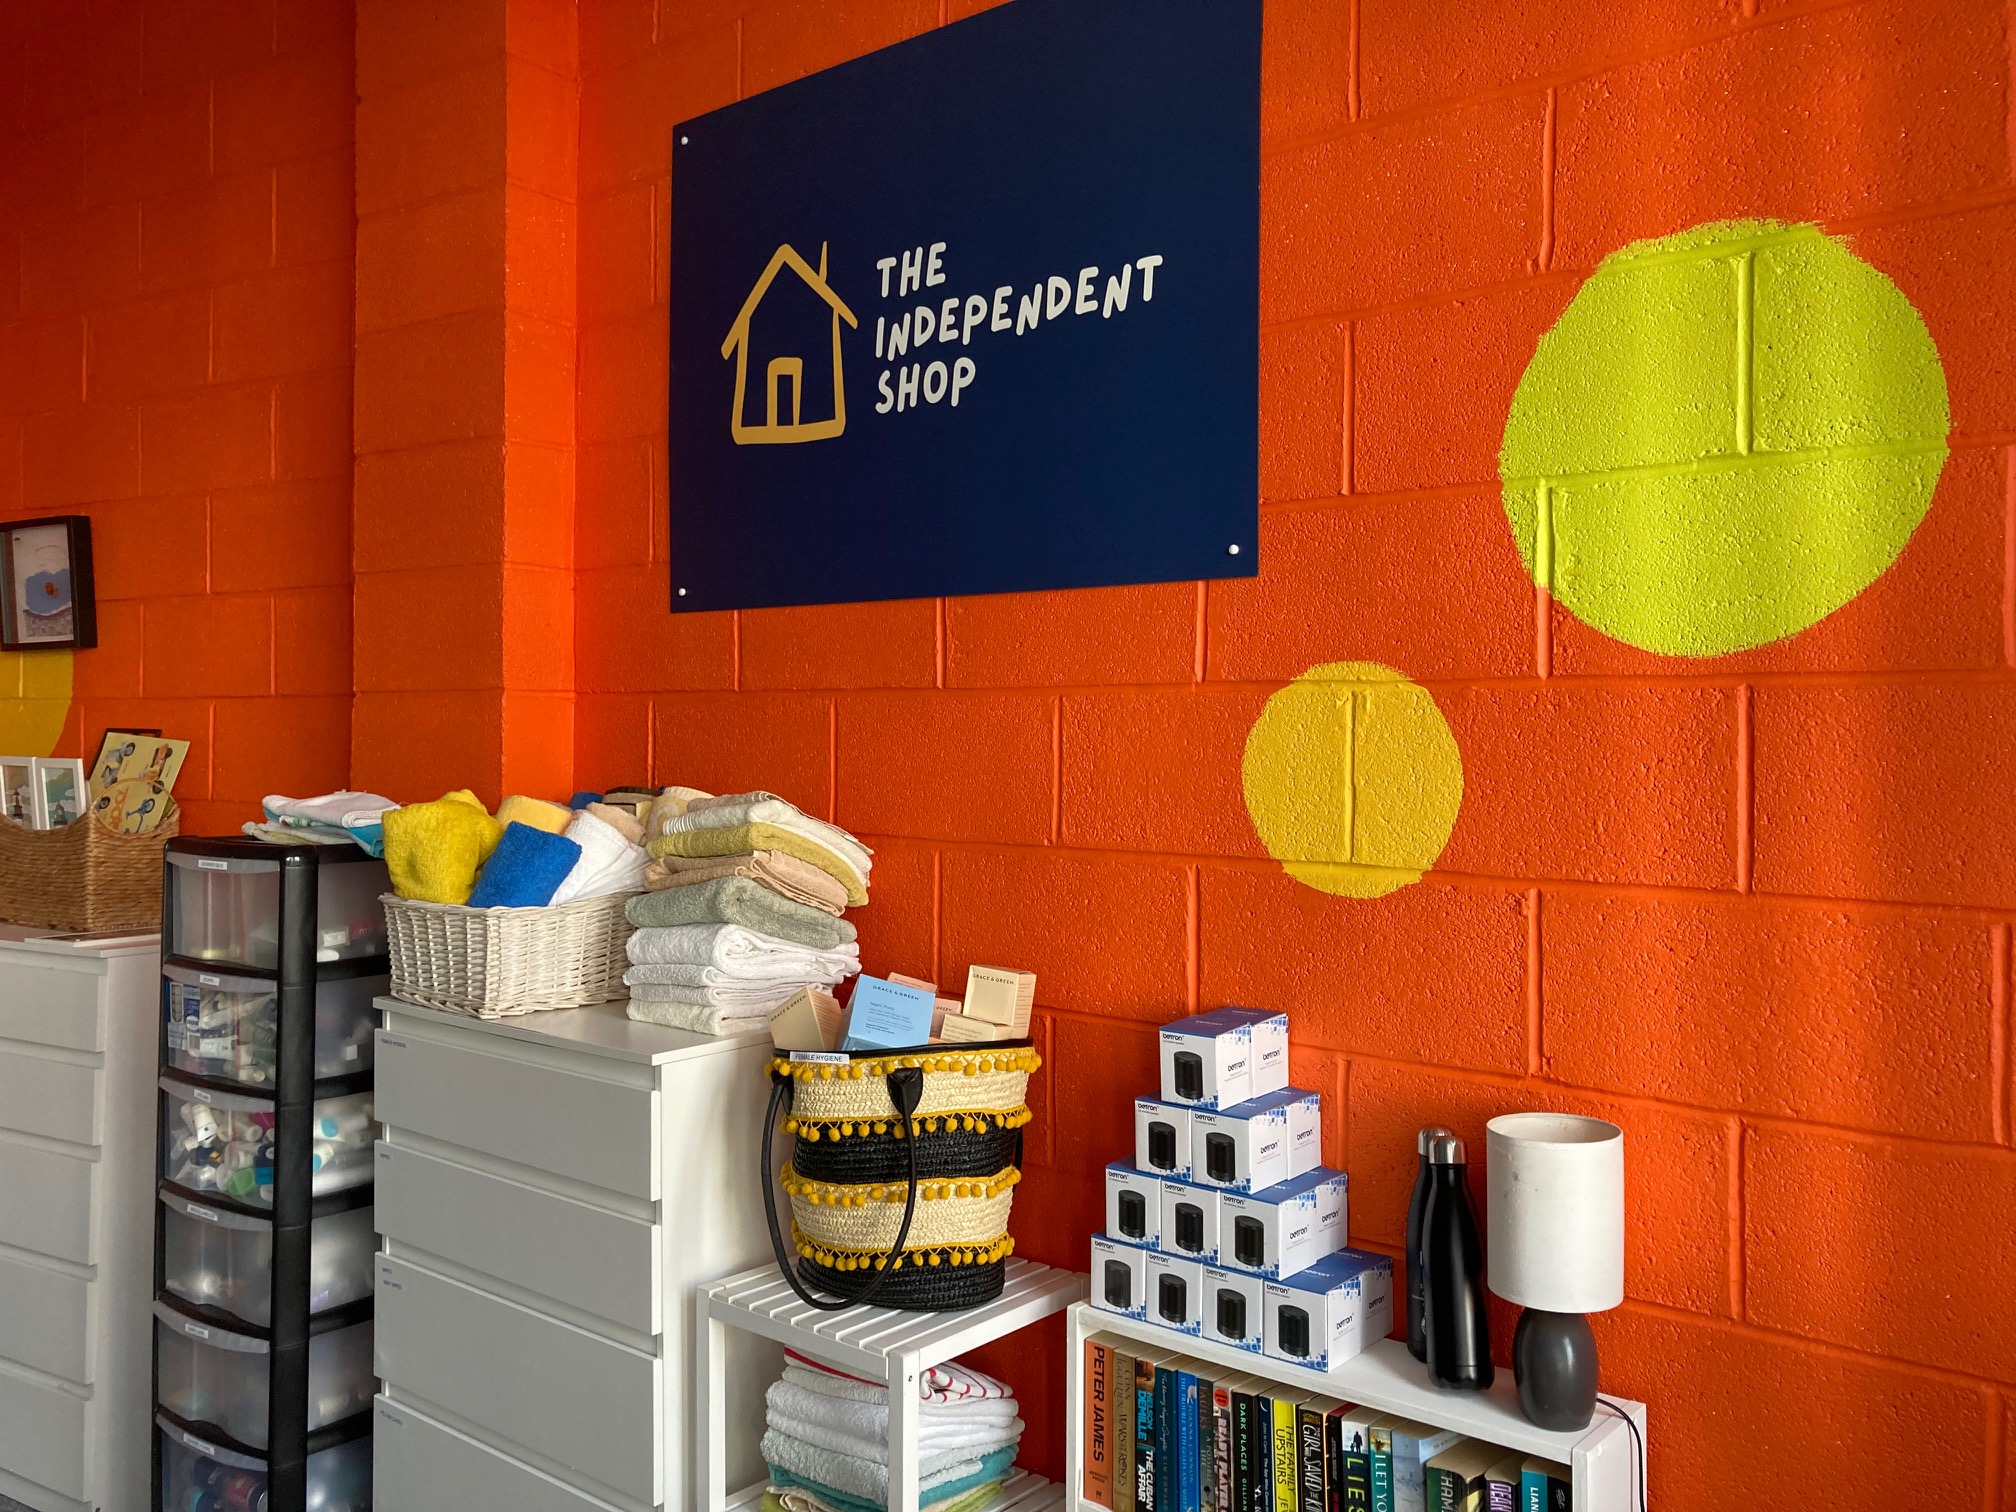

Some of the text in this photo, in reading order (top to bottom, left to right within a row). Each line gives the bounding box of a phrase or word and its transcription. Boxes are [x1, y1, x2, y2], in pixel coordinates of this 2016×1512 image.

[876, 241, 947, 298] THE
[875, 254, 1163, 362] INDEPENDENT
[875, 357, 976, 415] SHOP
[873, 985, 893, 993] GRACE
[899, 992, 919, 1001] GREEN
[770, 1009, 786, 1022] GRACE
[790, 994, 808, 1008] GREEN
[1163, 1033, 1183, 1041] betron
[795, 1053, 843, 1063] FEMALE HYGIENE
[1227, 1060, 1246, 1072] betron
[1262, 1049, 1281, 1060] betron
[1138, 1103, 1158, 1111] betron
[1195, 1113, 1215, 1122] betron
[1108, 1171, 1128, 1180] betron
[1164, 1183, 1184, 1192] betron
[1223, 1195, 1245, 1205] betron
[1289, 1226, 1308, 1239] betron
[1206, 1268, 1227, 1278] betron
[1266, 1284, 1289, 1294] betron
[1094, 1346, 1105, 1462] PETER JAMES
[1138, 1389, 1147, 1441] DEMILLE
[1146, 1392, 1154, 1430] NELSON
[1217, 1418, 1228, 1459] READY
[1240, 1433, 1248, 1471] PLACES
[1302, 1424, 1321, 1452] GIRL
[1276, 1428, 1287, 1485] UPSTAIRS
[1286, 1425, 1296, 1495] THE FAMILY
[1138, 1464, 1146, 1502] AFFAIR
[1146, 1449, 1154, 1511] THE CUBAN
[1218, 1460, 1229, 1508] PLAYER
[1304, 1457, 1323, 1492] SAVED
[1375, 1463, 1387, 1489] LET
[1441, 1475, 1454, 1512] HAM
[1530, 1487, 1539, 1512] LIAN
